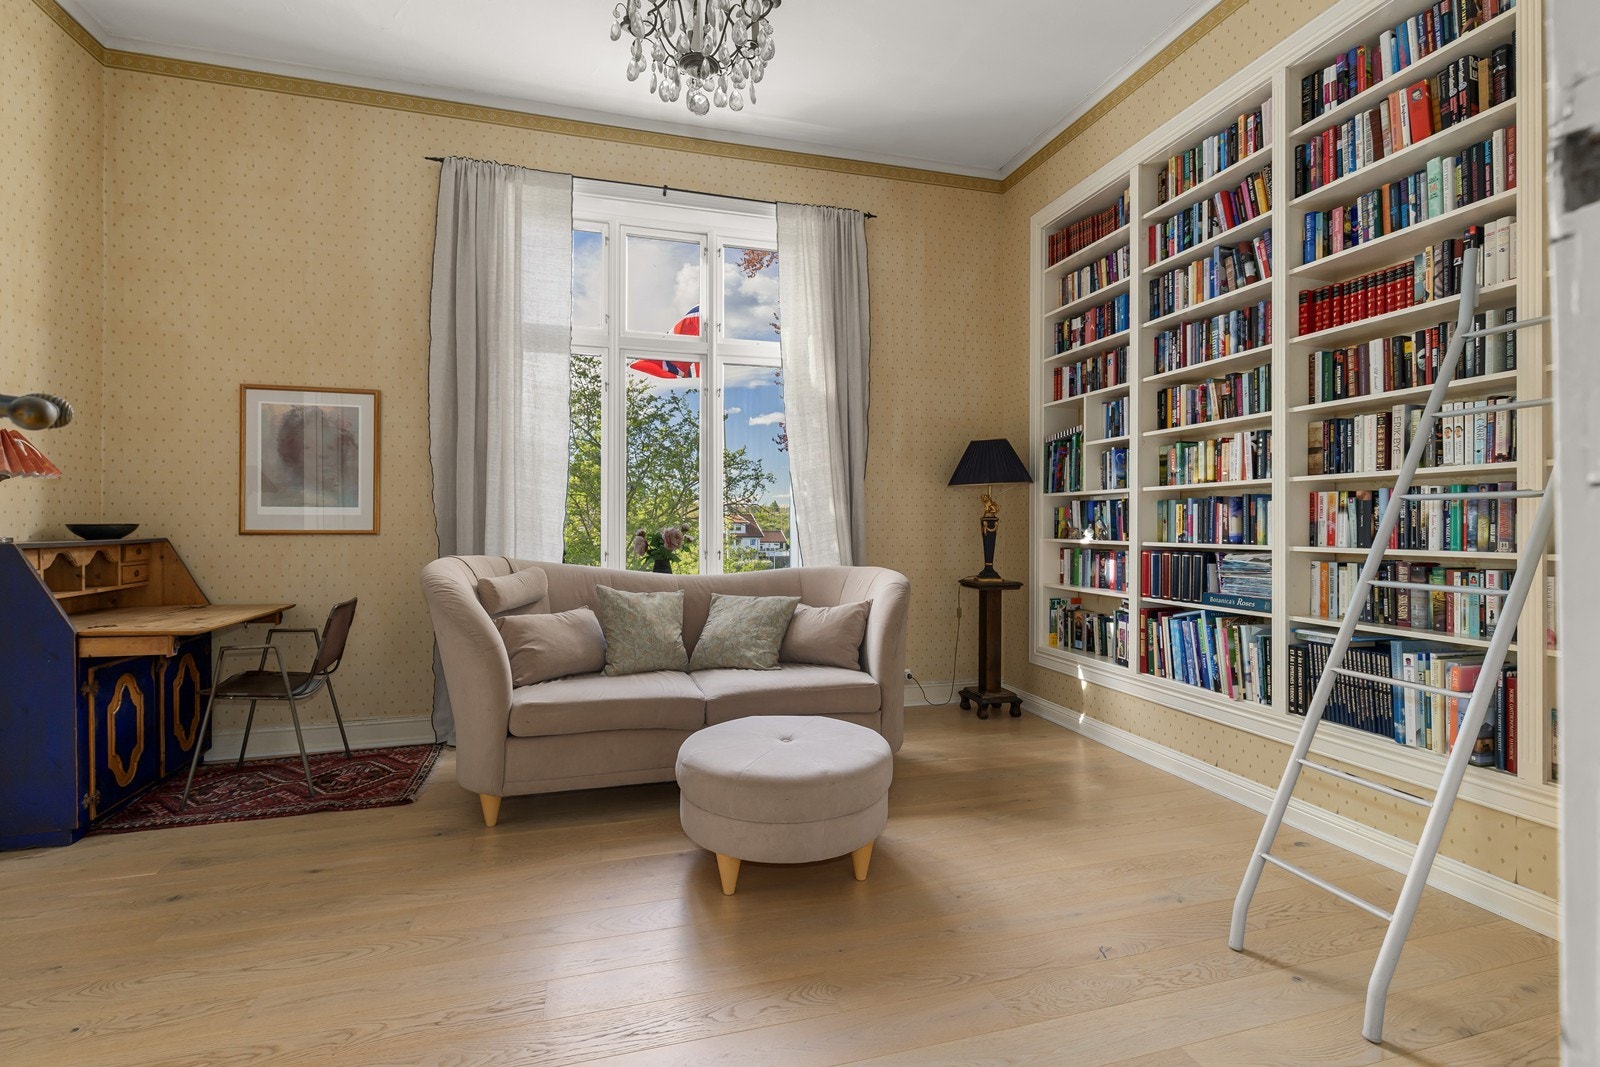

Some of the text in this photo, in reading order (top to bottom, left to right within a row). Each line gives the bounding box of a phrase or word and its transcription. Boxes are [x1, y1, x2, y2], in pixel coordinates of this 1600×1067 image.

[1393, 416, 1402, 454] ERIK BYE
[1209, 596, 1256, 608] Botanica's Roses
